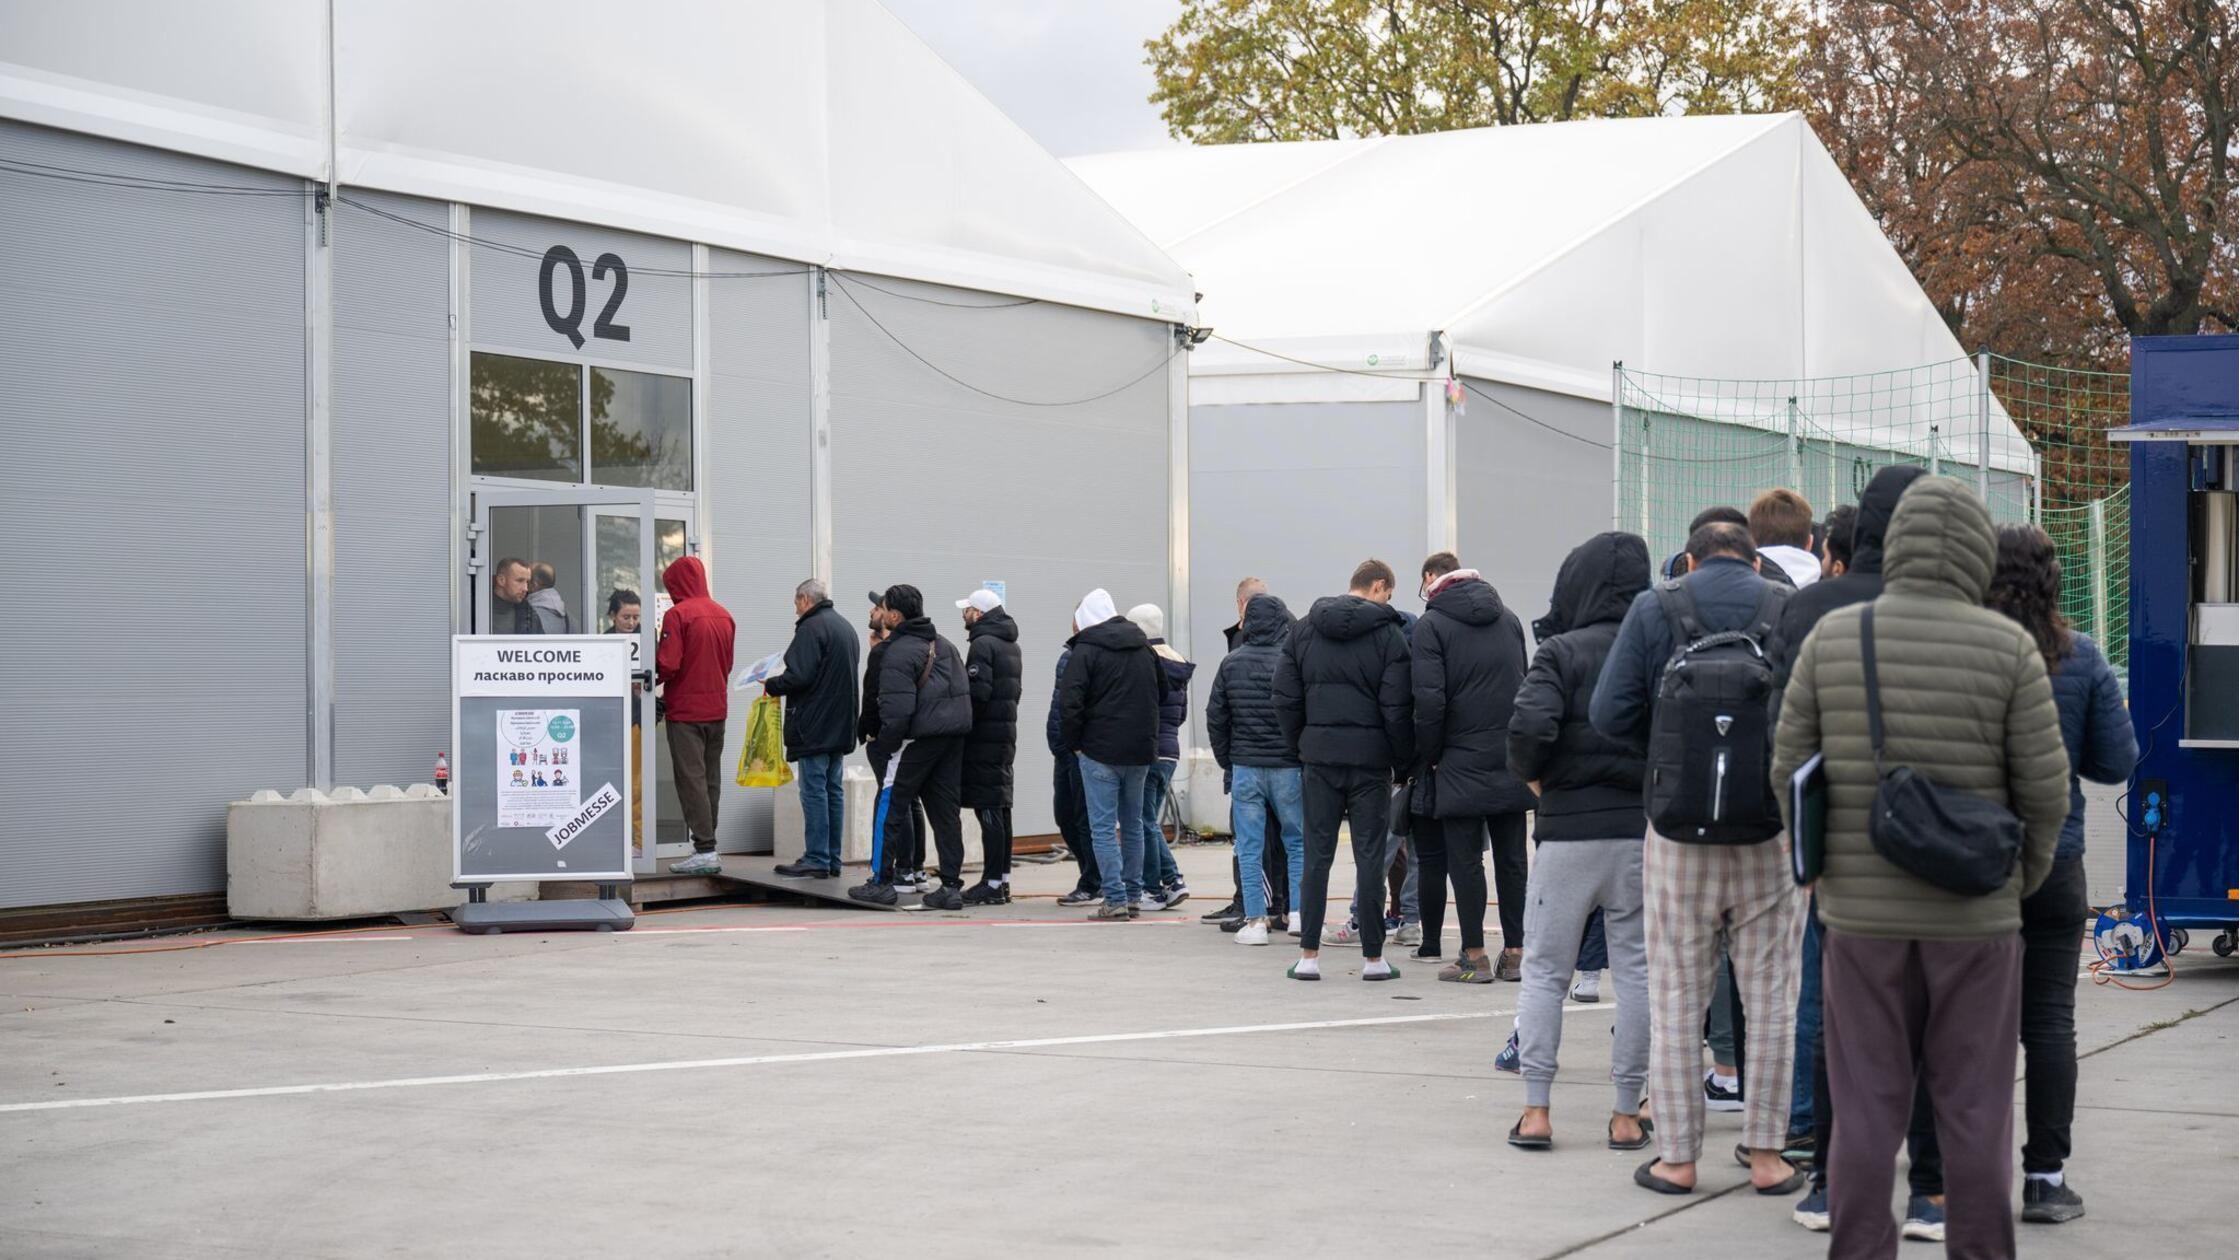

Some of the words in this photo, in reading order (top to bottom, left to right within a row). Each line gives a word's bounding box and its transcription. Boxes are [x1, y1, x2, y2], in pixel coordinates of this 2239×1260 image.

[539, 245, 630, 350] Q2
[497, 650, 581, 663] WELCOME
[474, 671, 535, 681] ласкаво
[538, 671, 604, 685] просимо
[554, 791, 615, 845] JOBMESSE
